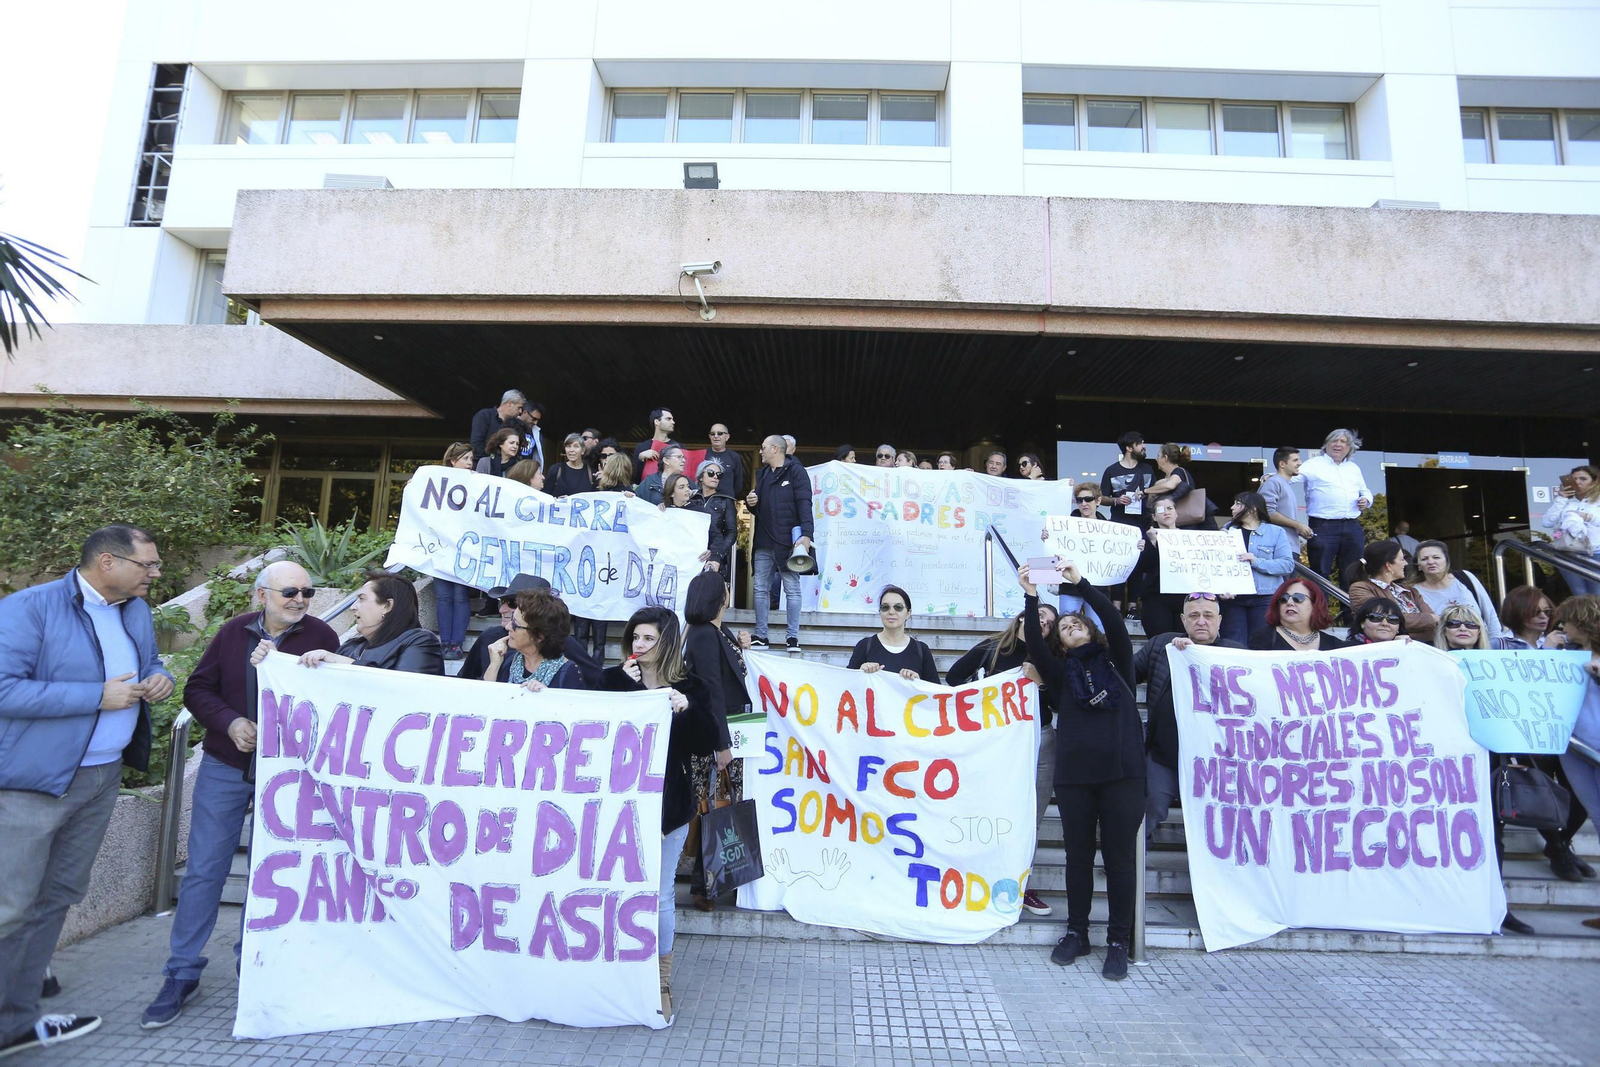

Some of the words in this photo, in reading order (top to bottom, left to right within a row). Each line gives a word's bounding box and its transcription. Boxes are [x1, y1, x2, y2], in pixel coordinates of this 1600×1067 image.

[1439, 455, 1468, 464] ENTRADA
[420, 476, 468, 511] NO
[474, 485, 505, 519] AL
[515, 495, 629, 534] CIERRE
[813, 471, 854, 495] LOS
[986, 485, 1020, 509] DE
[815, 495, 857, 519] LOS
[867, 500, 966, 529] PADRES
[974, 510, 1007, 534] DE
[1051, 517, 1069, 531] EN
[1057, 535, 1076, 551] NO
[1081, 537, 1097, 554] SE
[1102, 539, 1133, 556] GASTA
[1160, 532, 1179, 546] NO
[1182, 533, 1195, 546] AL
[1167, 548, 1185, 560] DEL
[1186, 549, 1226, 562] CENTRO
[454, 531, 596, 598] CENTRO
[598, 552, 619, 585] de
[860, 549, 884, 568] No
[1087, 560, 1133, 579] INVIERTE
[1169, 560, 1188, 573] SAN
[1191, 563, 1207, 577] FCO
[1210, 564, 1223, 577] DE
[1462, 658, 1496, 681] LO
[758, 674, 819, 726] NO
[836, 687, 896, 737] AL
[904, 677, 1034, 737] CIERRE
[1188, 663, 1256, 718] LAS
[1472, 689, 1520, 719] NO
[1528, 691, 1563, 721] SE
[382, 711, 609, 794] CIERRE
[1214, 712, 1384, 761] JUDICIALES
[1387, 708, 1434, 758] DE
[1513, 719, 1575, 750] VEND
[758, 731, 830, 784] SAN
[856, 755, 960, 800] FCO
[1192, 757, 1354, 807] MENORES
[259, 769, 468, 867] CENTRO
[475, 807, 517, 855] DE
[531, 798, 648, 882] DIA
[771, 788, 924, 859] SOMOS
[945, 815, 1012, 845] STOP
[1204, 802, 1273, 867] UN
[1290, 806, 1485, 874] NEGOCIO
[719, 843, 746, 866] SGDT
[449, 881, 521, 952] DE
[528, 887, 659, 962] ASIS
